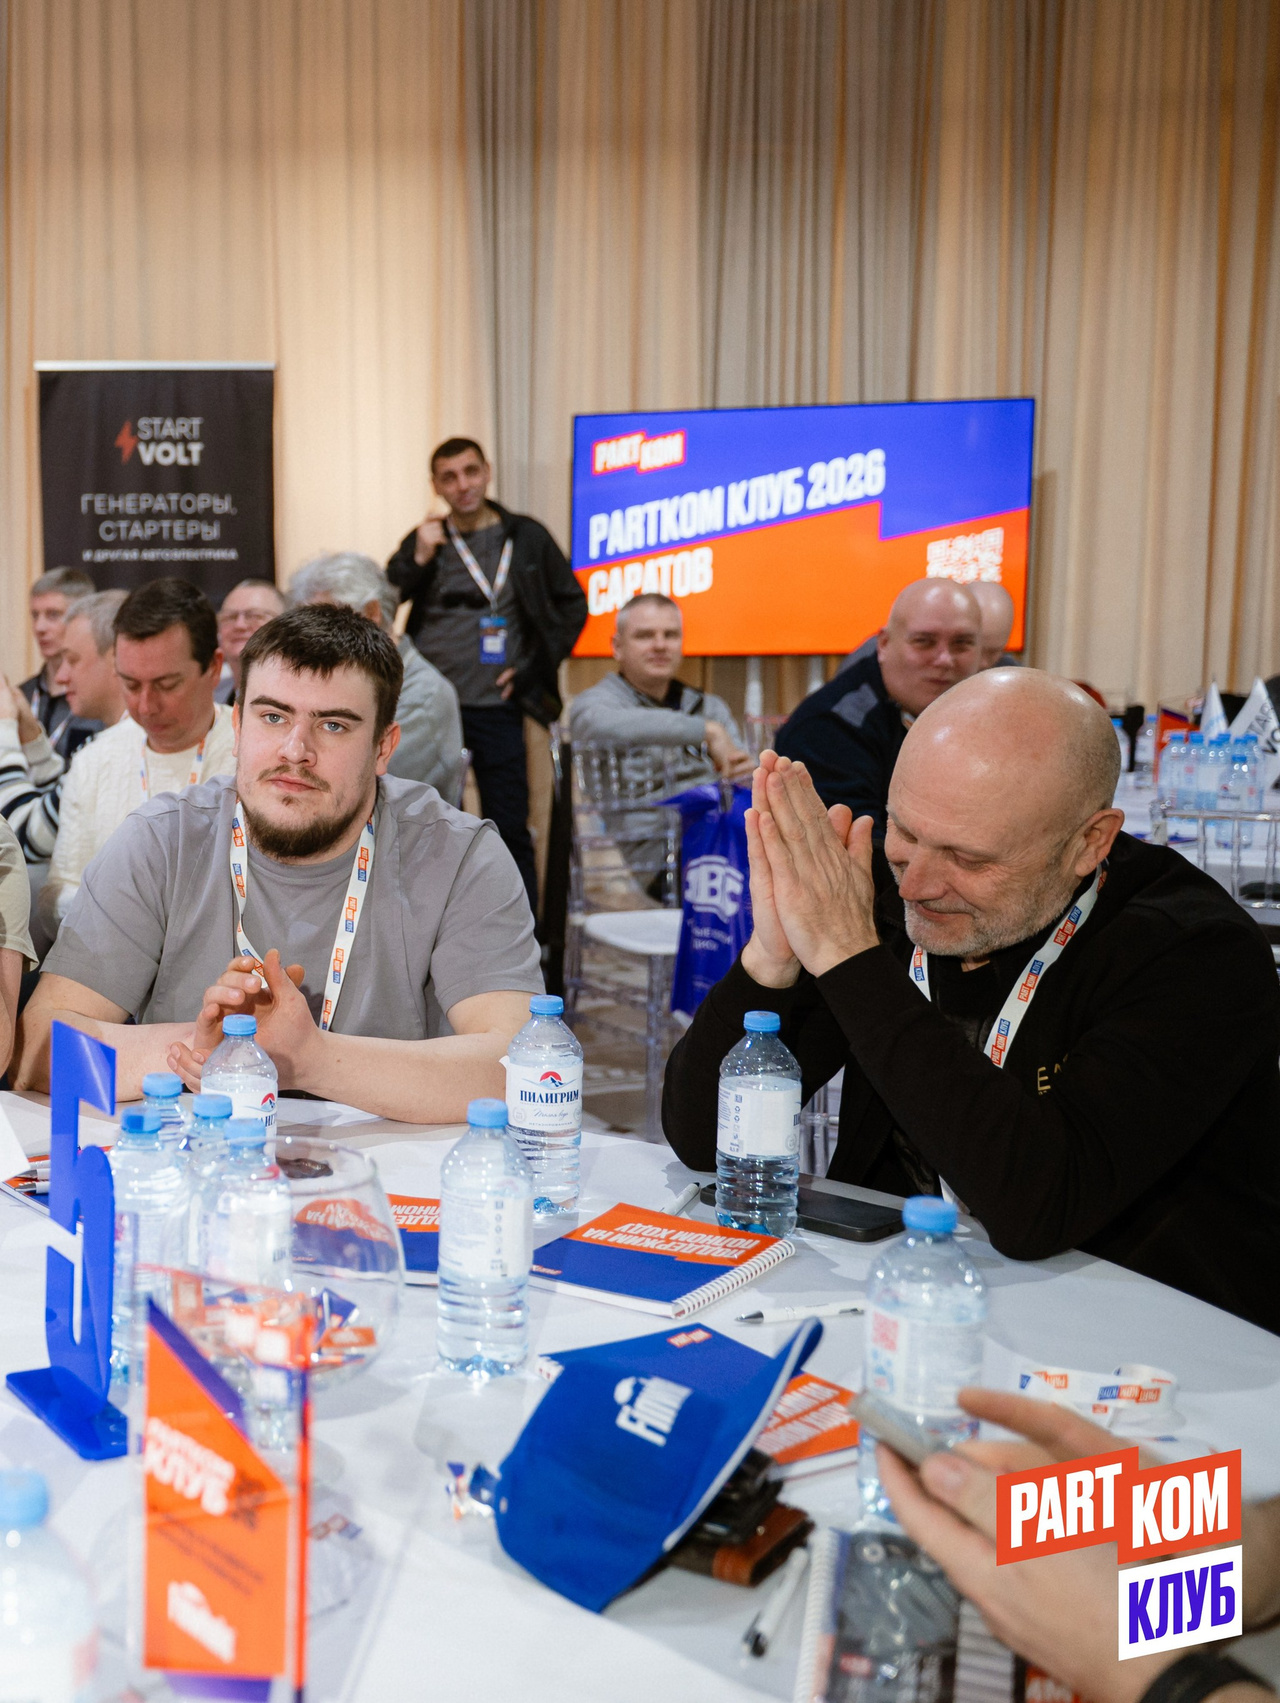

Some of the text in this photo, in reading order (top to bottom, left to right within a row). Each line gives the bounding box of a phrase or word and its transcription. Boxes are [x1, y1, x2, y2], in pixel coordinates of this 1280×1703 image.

[137, 416, 205, 441] START
[137, 441, 205, 466] VOLT
[594, 434, 642, 473] PART
[588, 448, 887, 559] PARTKOM КЛУБ 2026
[98, 519, 220, 542] СТАРТЕРЫ
[587, 546, 714, 617] САРАТОВ
[1018, 983, 1032, 1002] PART
[1029, 960, 1045, 976] КЛУБ
[997, 1018, 1011, 1037] КЛУБ
[995, 1033, 1008, 1052] KOM
[520, 1088, 580, 1104] ПИЛИГРИМ
[581, 1227, 747, 1260] ПОДДЕРЖИМ НА
[614, 1222, 761, 1250] ПОЛНОМ ХОДУ
